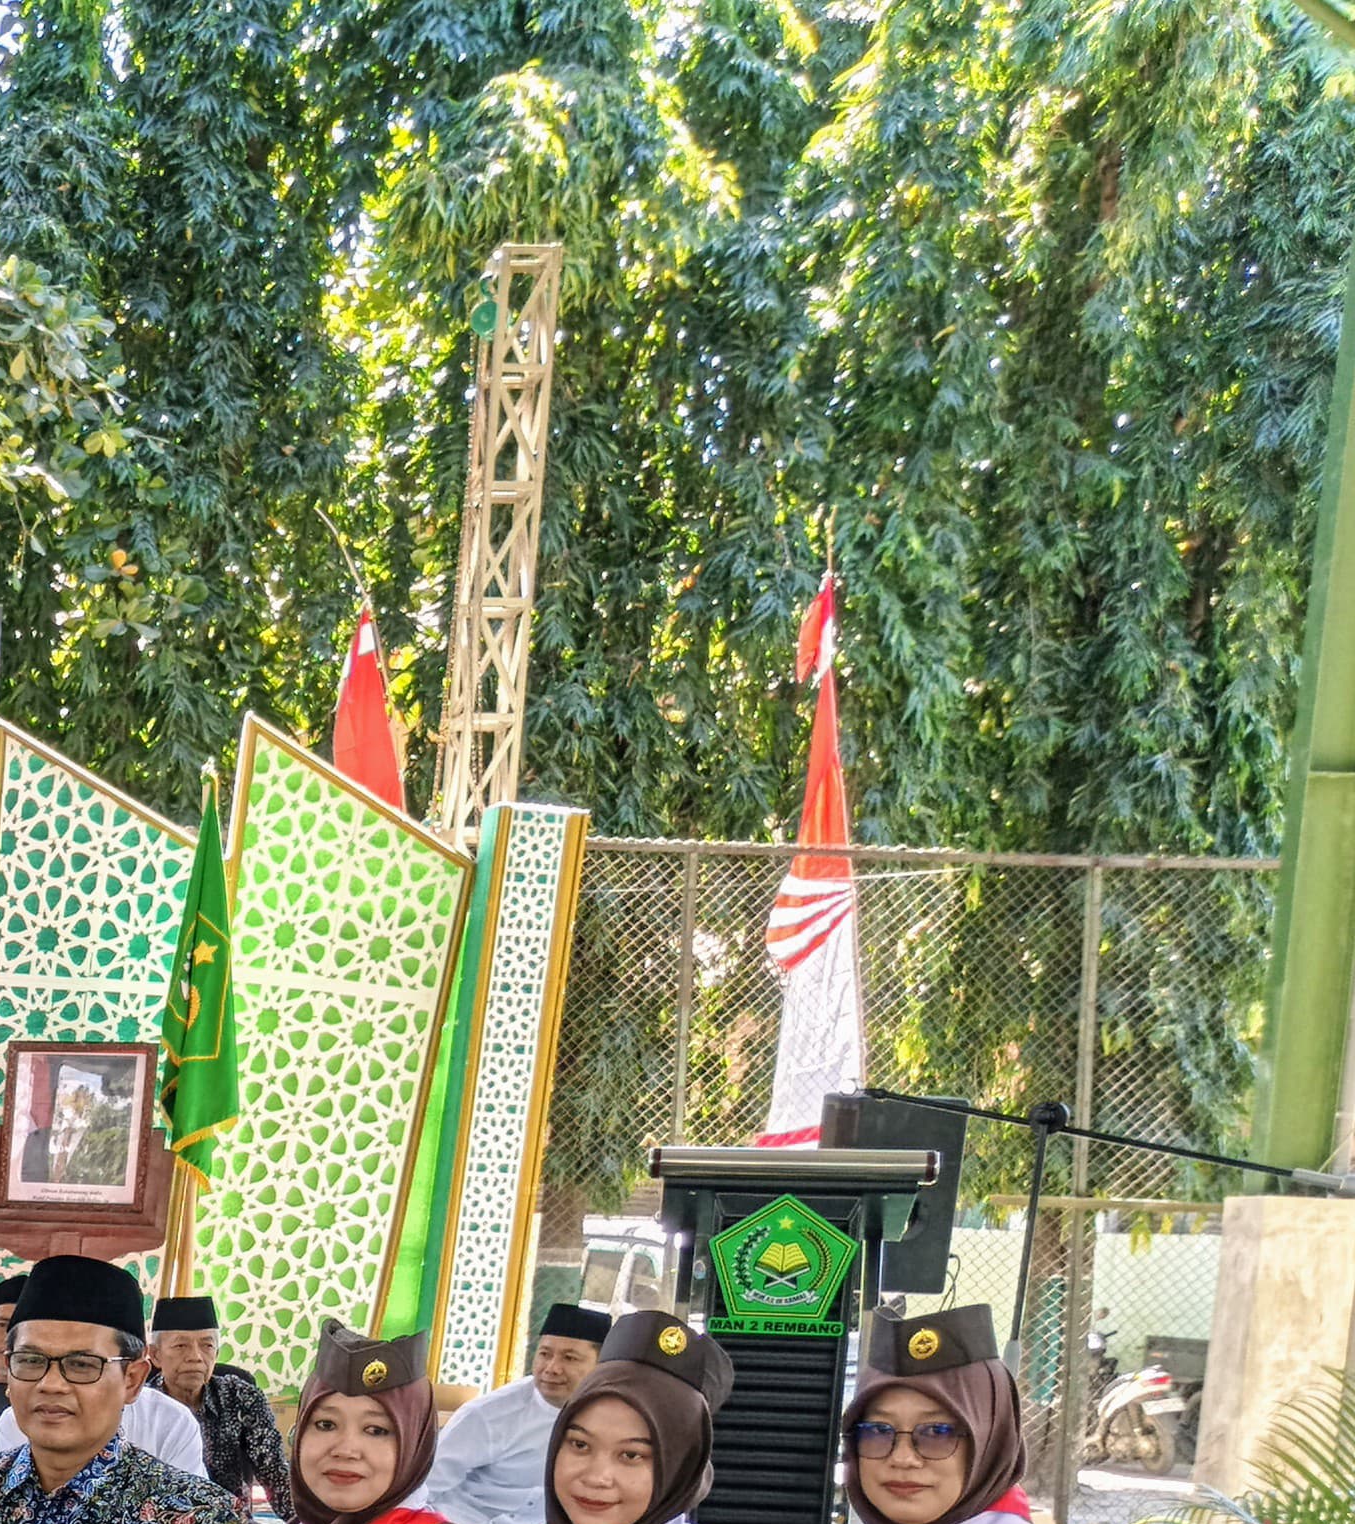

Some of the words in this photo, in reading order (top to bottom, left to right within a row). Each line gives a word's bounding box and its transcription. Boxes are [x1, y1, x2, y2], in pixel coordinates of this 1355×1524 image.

[710, 1319, 745, 1331] MAN
[750, 1321, 759, 1332] 2
[763, 1321, 841, 1334] REMBANG
